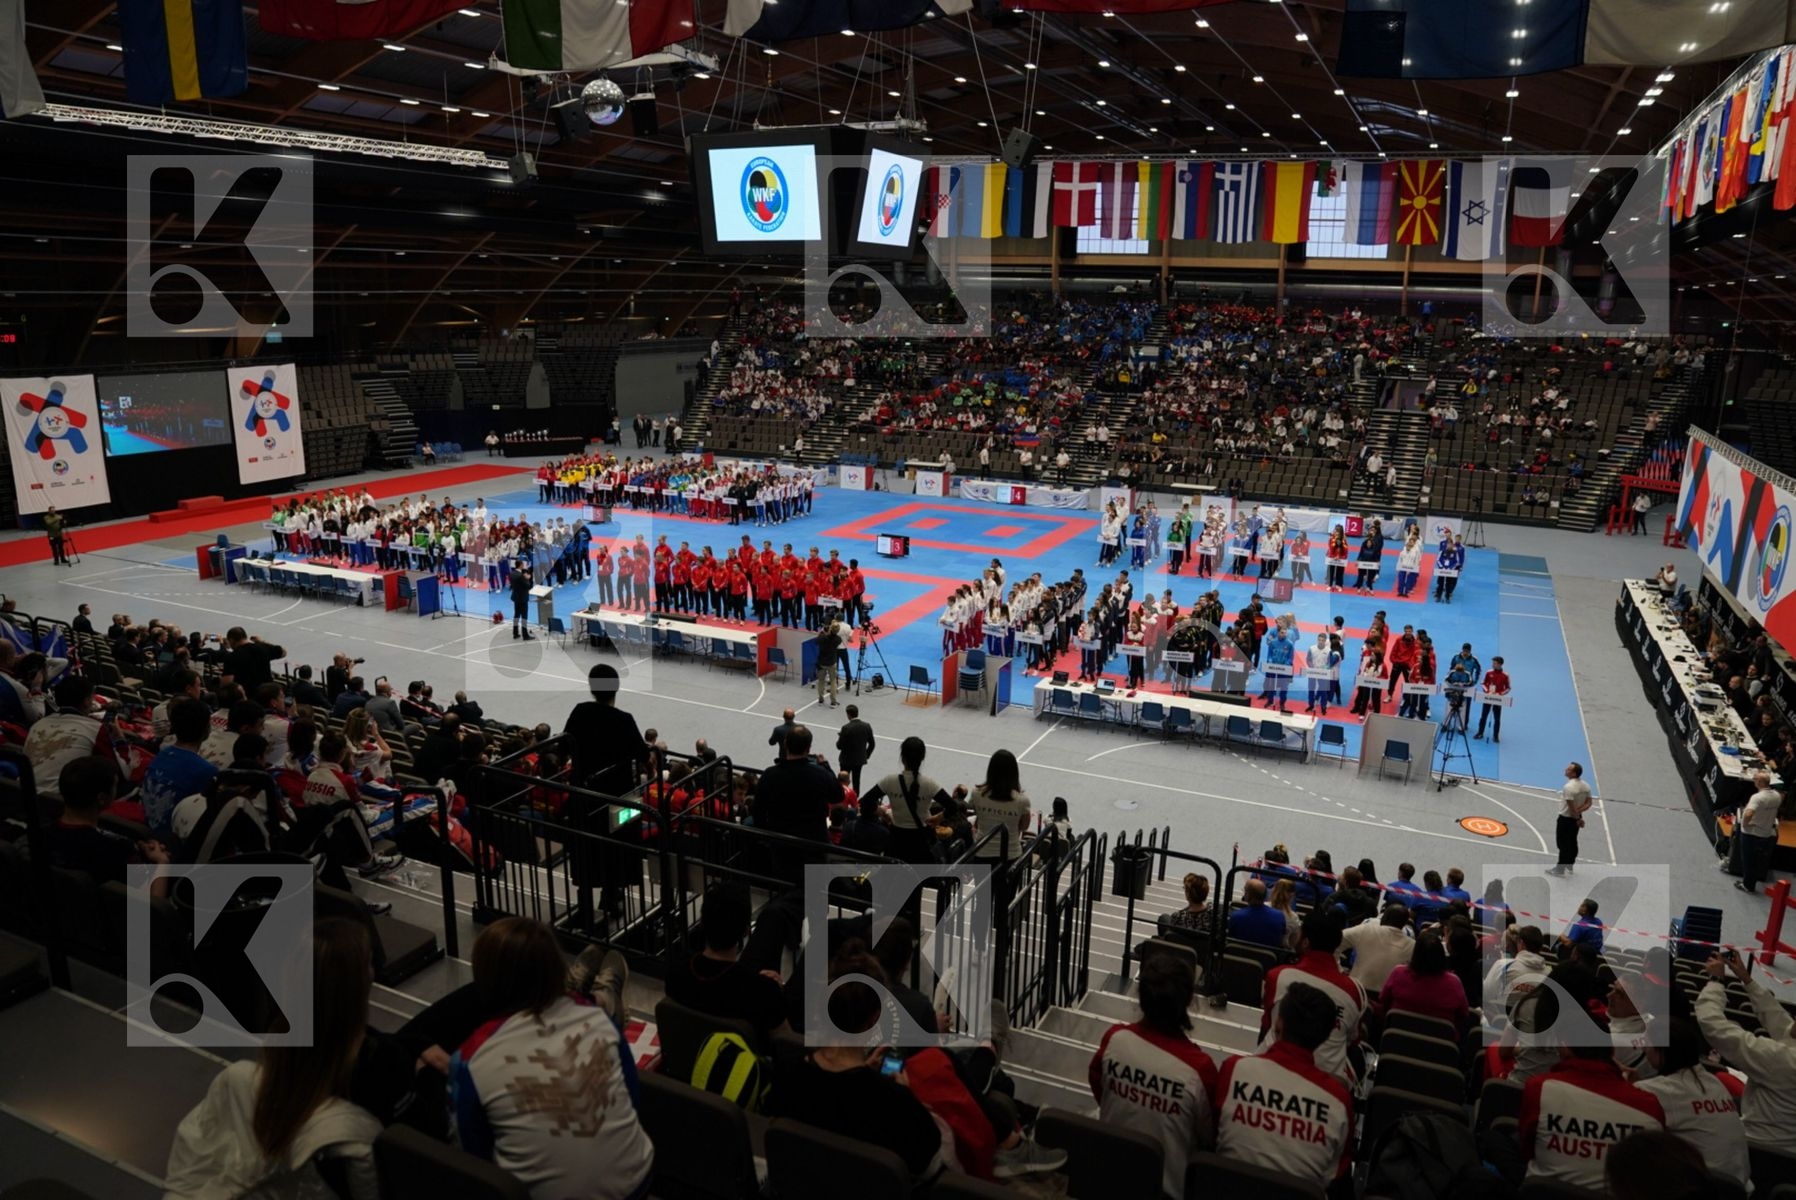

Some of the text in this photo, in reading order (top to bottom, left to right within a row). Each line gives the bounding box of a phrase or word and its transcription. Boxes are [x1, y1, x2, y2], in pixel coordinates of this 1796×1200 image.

[752, 187, 776, 202] WKF
[1015, 491, 1021, 500] 4
[1350, 521, 1358, 532] 2
[894, 542, 900, 552] 3
[1106, 1058, 1185, 1099] KARATE
[1108, 1078, 1182, 1117] AUSTRIA
[1232, 1080, 1330, 1124] KARATE
[1231, 1103, 1328, 1147] AUSTRIA
